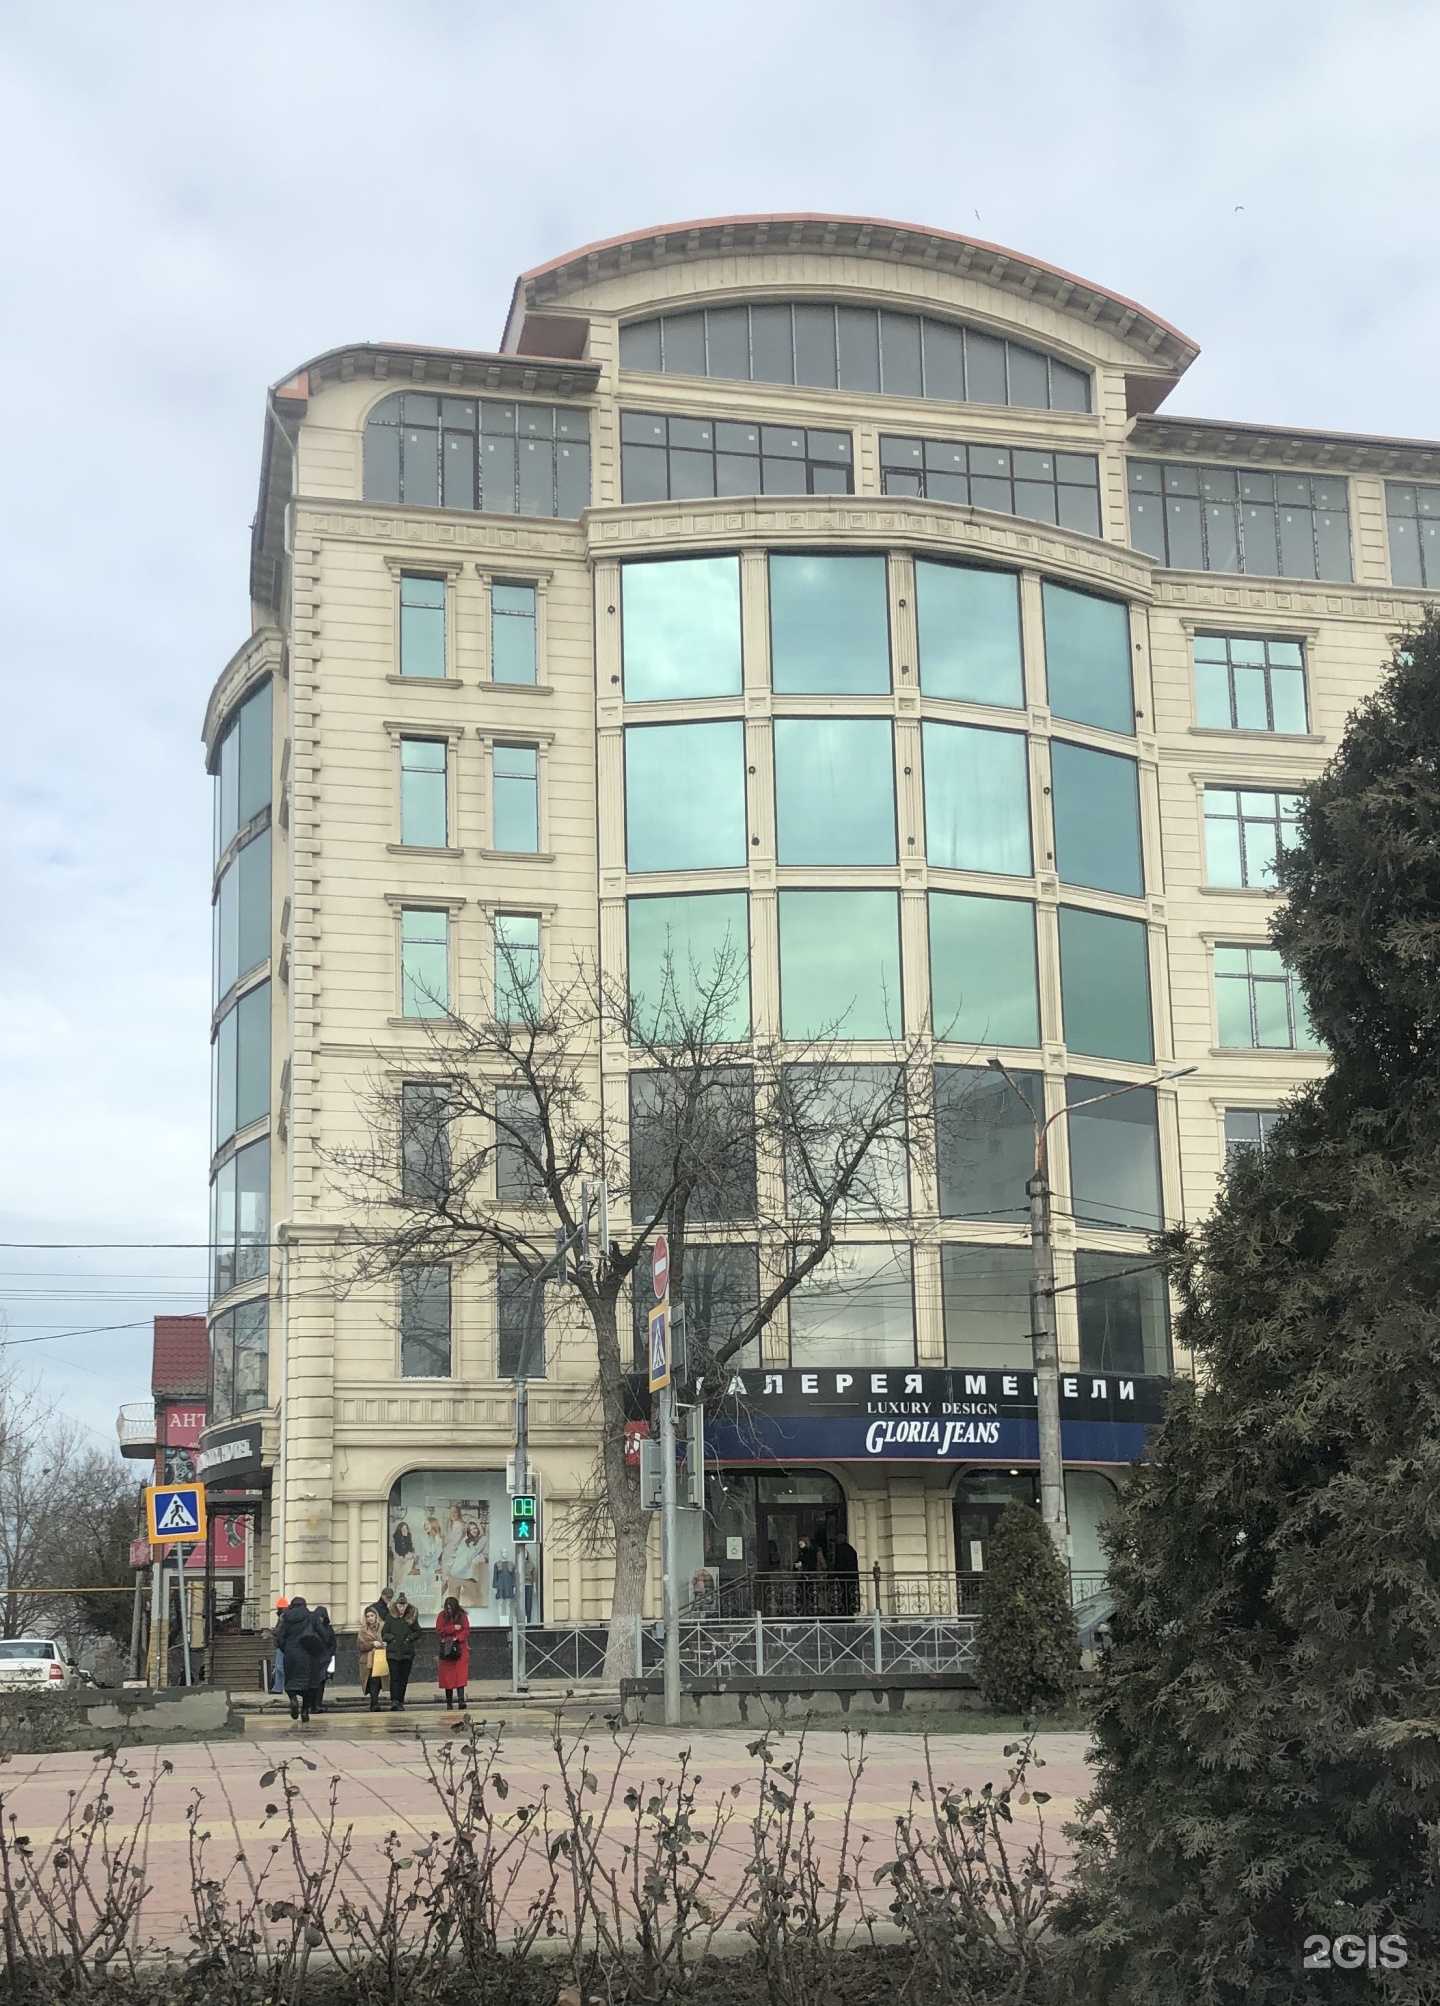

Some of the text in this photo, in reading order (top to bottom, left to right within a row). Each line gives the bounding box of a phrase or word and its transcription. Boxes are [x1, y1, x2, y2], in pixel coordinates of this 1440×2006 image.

[965, 1375, 1135, 1400] МЕЕЛИ
[867, 1402, 998, 1415] LUXURY DESIGN
[865, 1420, 1000, 1455] GLORIA JEANS
